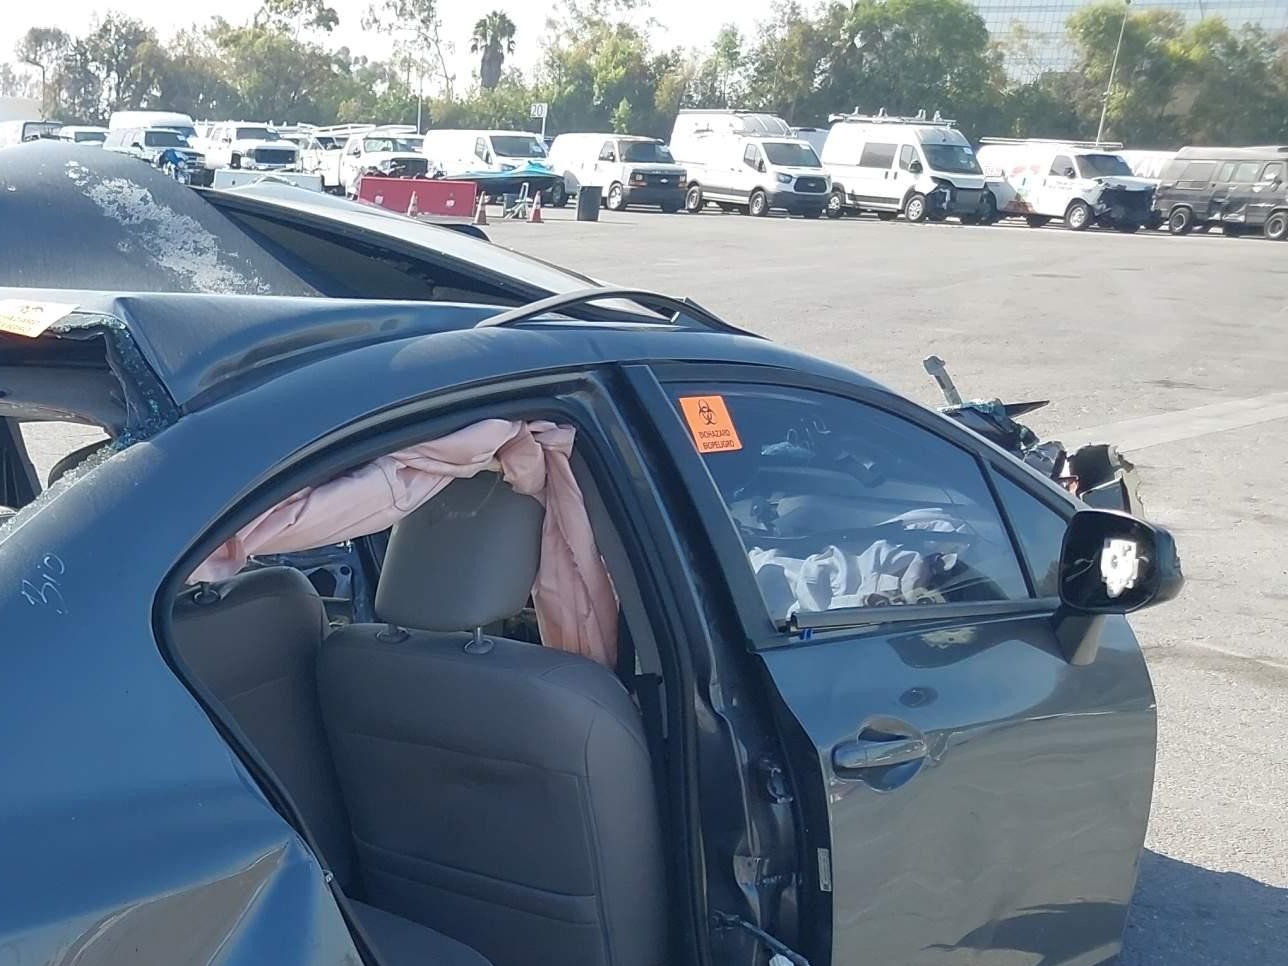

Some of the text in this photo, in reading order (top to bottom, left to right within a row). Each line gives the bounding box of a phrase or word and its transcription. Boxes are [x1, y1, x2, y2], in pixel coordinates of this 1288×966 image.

[532, 104, 543, 117] 20
[698, 429, 731, 439] BIOHAZARD
[702, 440, 735, 450] BIOPELIGRO
